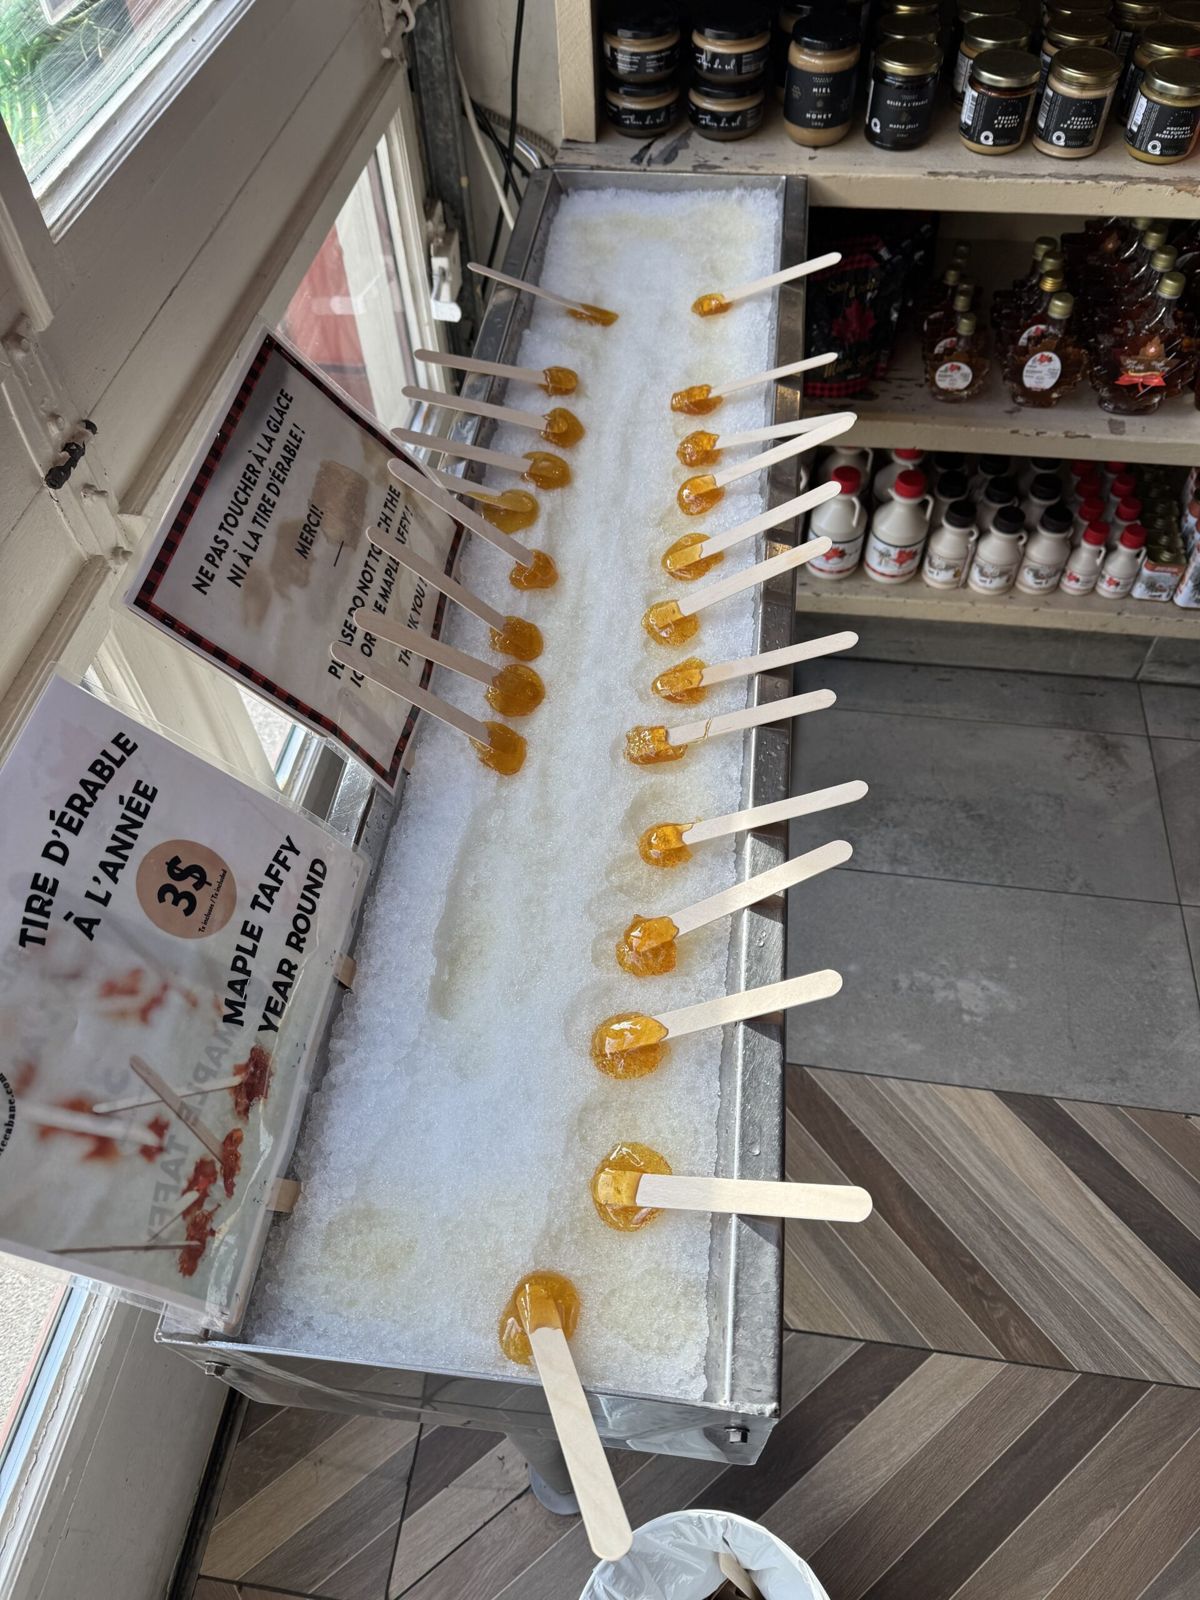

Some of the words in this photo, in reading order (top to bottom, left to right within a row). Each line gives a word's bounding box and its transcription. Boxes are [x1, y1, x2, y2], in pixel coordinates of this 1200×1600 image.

[266, 388, 294, 434] GLACE
[248, 449, 267, 468] À
[257, 433, 276, 454] LA
[218, 463, 262, 537] TOUCHER
[251, 493, 277, 530] TIRE
[204, 534, 230, 569] PAS
[242, 530, 263, 551] LA
[294, 504, 324, 560] MERCI!
[226, 563, 247, 588] NI
[233, 549, 254, 568] À
[191, 565, 216, 596] NE
[328, 619, 358, 680] PLSE
[357, 559, 377, 596] NOT
[383, 484, 401, 514] THE
[360, 631, 377, 658] OR
[18, 872, 60, 948] TIRE
[41, 731, 139, 867] D'ÉRABLE
[63, 910, 101, 941] À
[84, 779, 159, 908] L'ANNÉE
[157, 855, 212, 917] 3$
[222, 919, 264, 1027] MAPLE
[249, 835, 301, 914] TAFFY
[257, 958, 299, 1033] YEAR
[285, 858, 328, 954] ROUND
